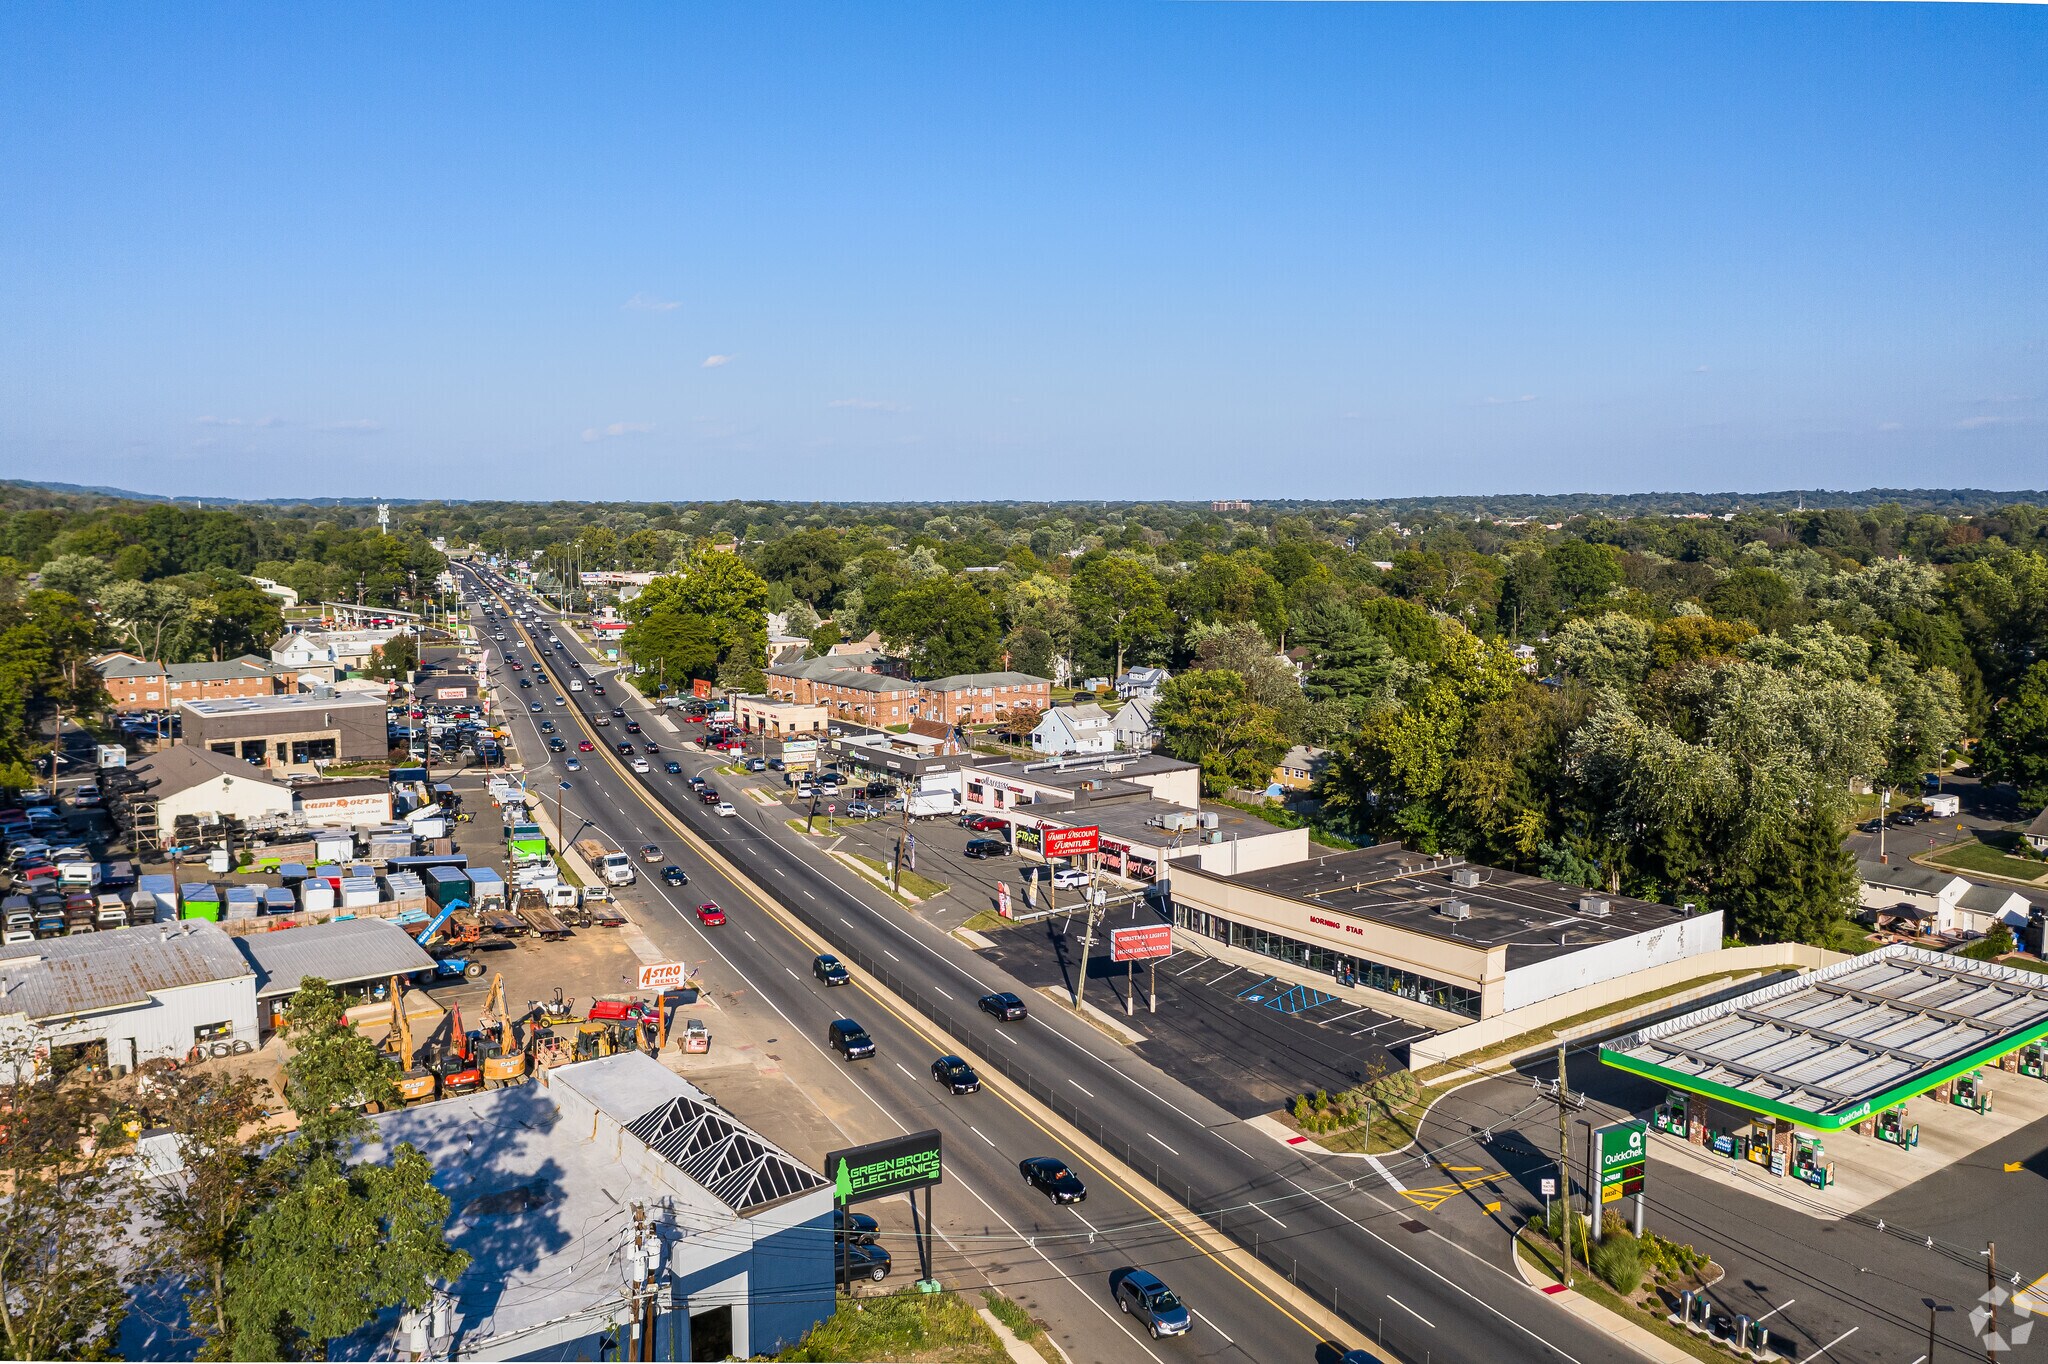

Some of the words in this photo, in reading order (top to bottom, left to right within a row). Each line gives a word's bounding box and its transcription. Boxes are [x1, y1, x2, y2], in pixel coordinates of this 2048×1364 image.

[1016, 830, 1040, 845] STORE
[1047, 832, 1066, 841] FAMILY
[1067, 830, 1096, 839] DISCOUNT
[1054, 840, 1090, 850] FURNITURE
[1126, 860, 1141, 874] MUST
[1142, 865, 1154, 876] GO
[1310, 916, 1340, 929] MORNING
[1346, 925, 1364, 935] STAR
[1118, 934, 1148, 942] CHRISTMAS
[1134, 945, 1169, 953] DECORATION
[642, 966, 680, 984] ASTRO
[1839, 1108, 1863, 1125] QuickChek
[1863, 1102, 1871, 1114] Q
[1629, 1132, 1641, 1147] Q
[850, 1158, 895, 1178] GREEN
[896, 1149, 939, 1168] BROOK
[1605, 1147, 1643, 1165] QuickChek
[853, 1160, 940, 1188] ELECTRONICS
[1604, 1189, 1617, 1198] DIESEL
